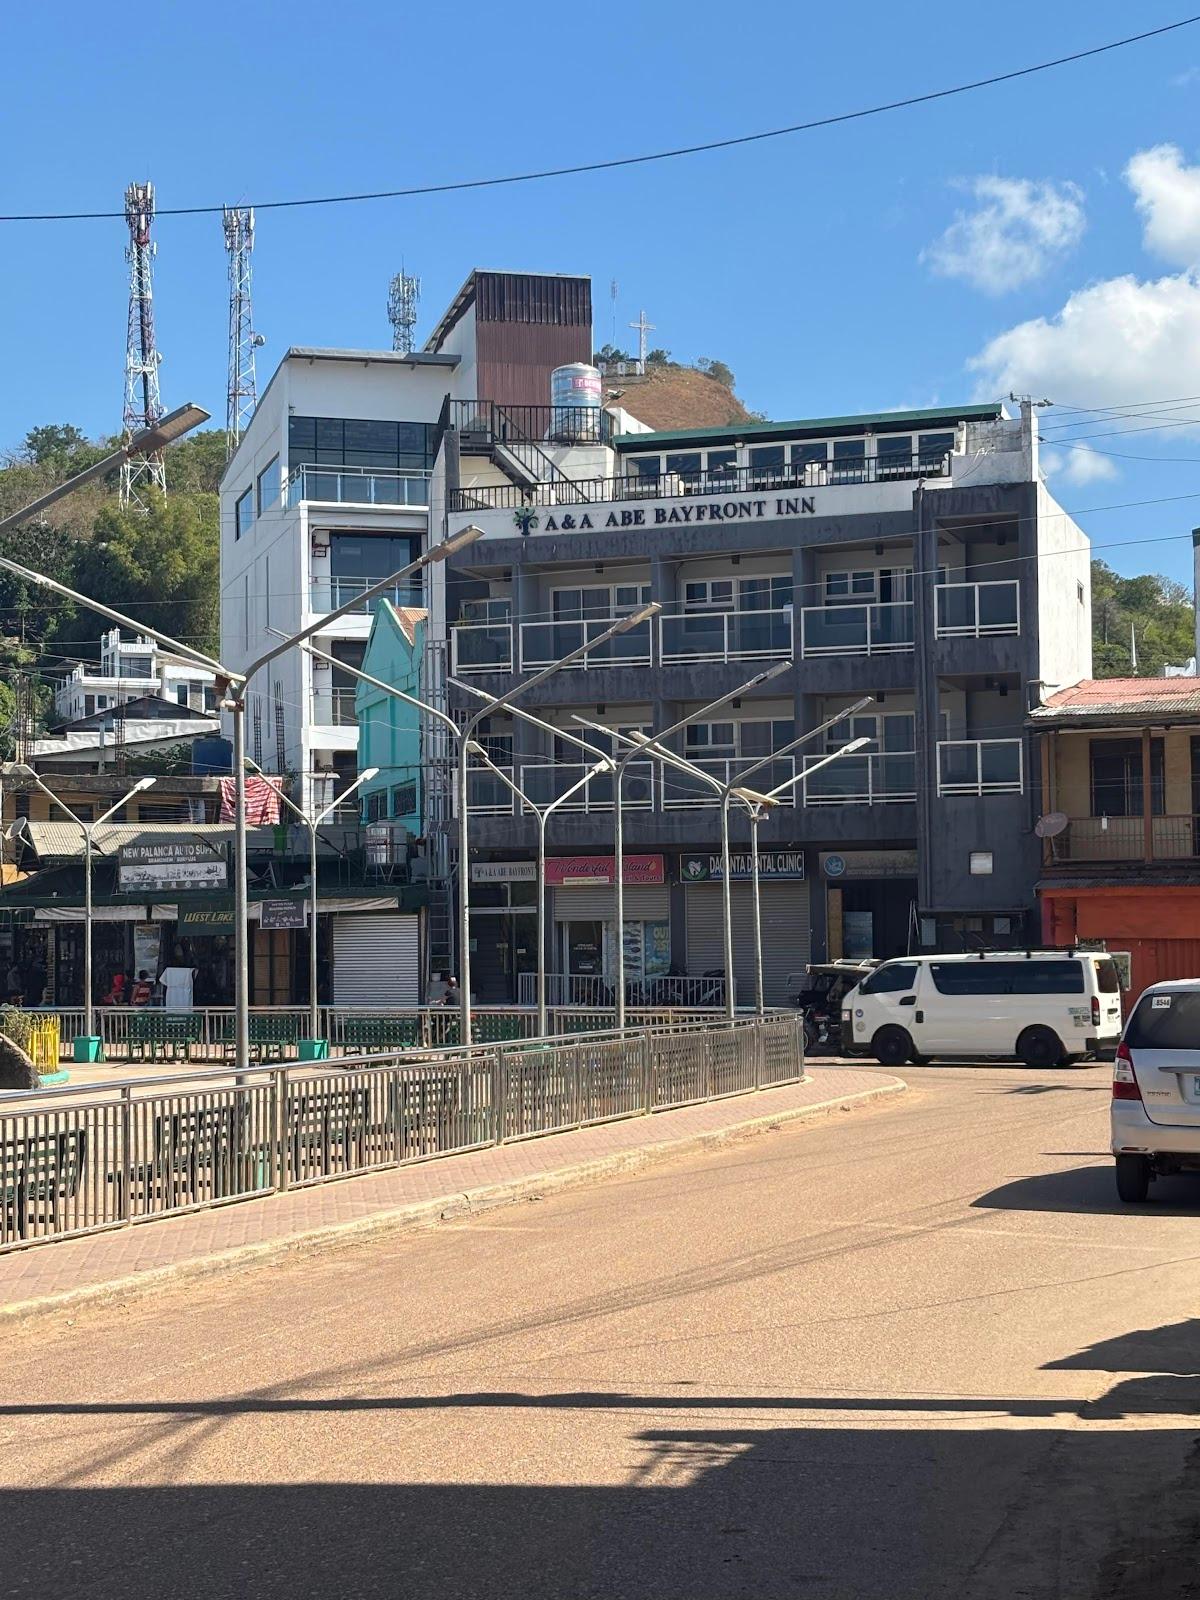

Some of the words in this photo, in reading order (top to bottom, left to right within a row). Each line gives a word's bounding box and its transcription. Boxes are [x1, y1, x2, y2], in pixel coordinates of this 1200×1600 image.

[545, 513, 593, 530] A&A
[605, 509, 646, 527] ABE
[654, 501, 767, 524] BAYFRONT
[776, 497, 815, 515] INN
[123, 847, 139, 858] NEW
[140, 846, 173, 858] PALANCA
[174, 845, 194, 856] AUTO
[619, 859, 651, 872] sland
[710, 855, 746, 873] DACNTA
[747, 854, 776, 872] DNTAL
[777, 854, 802, 872] CLINIC
